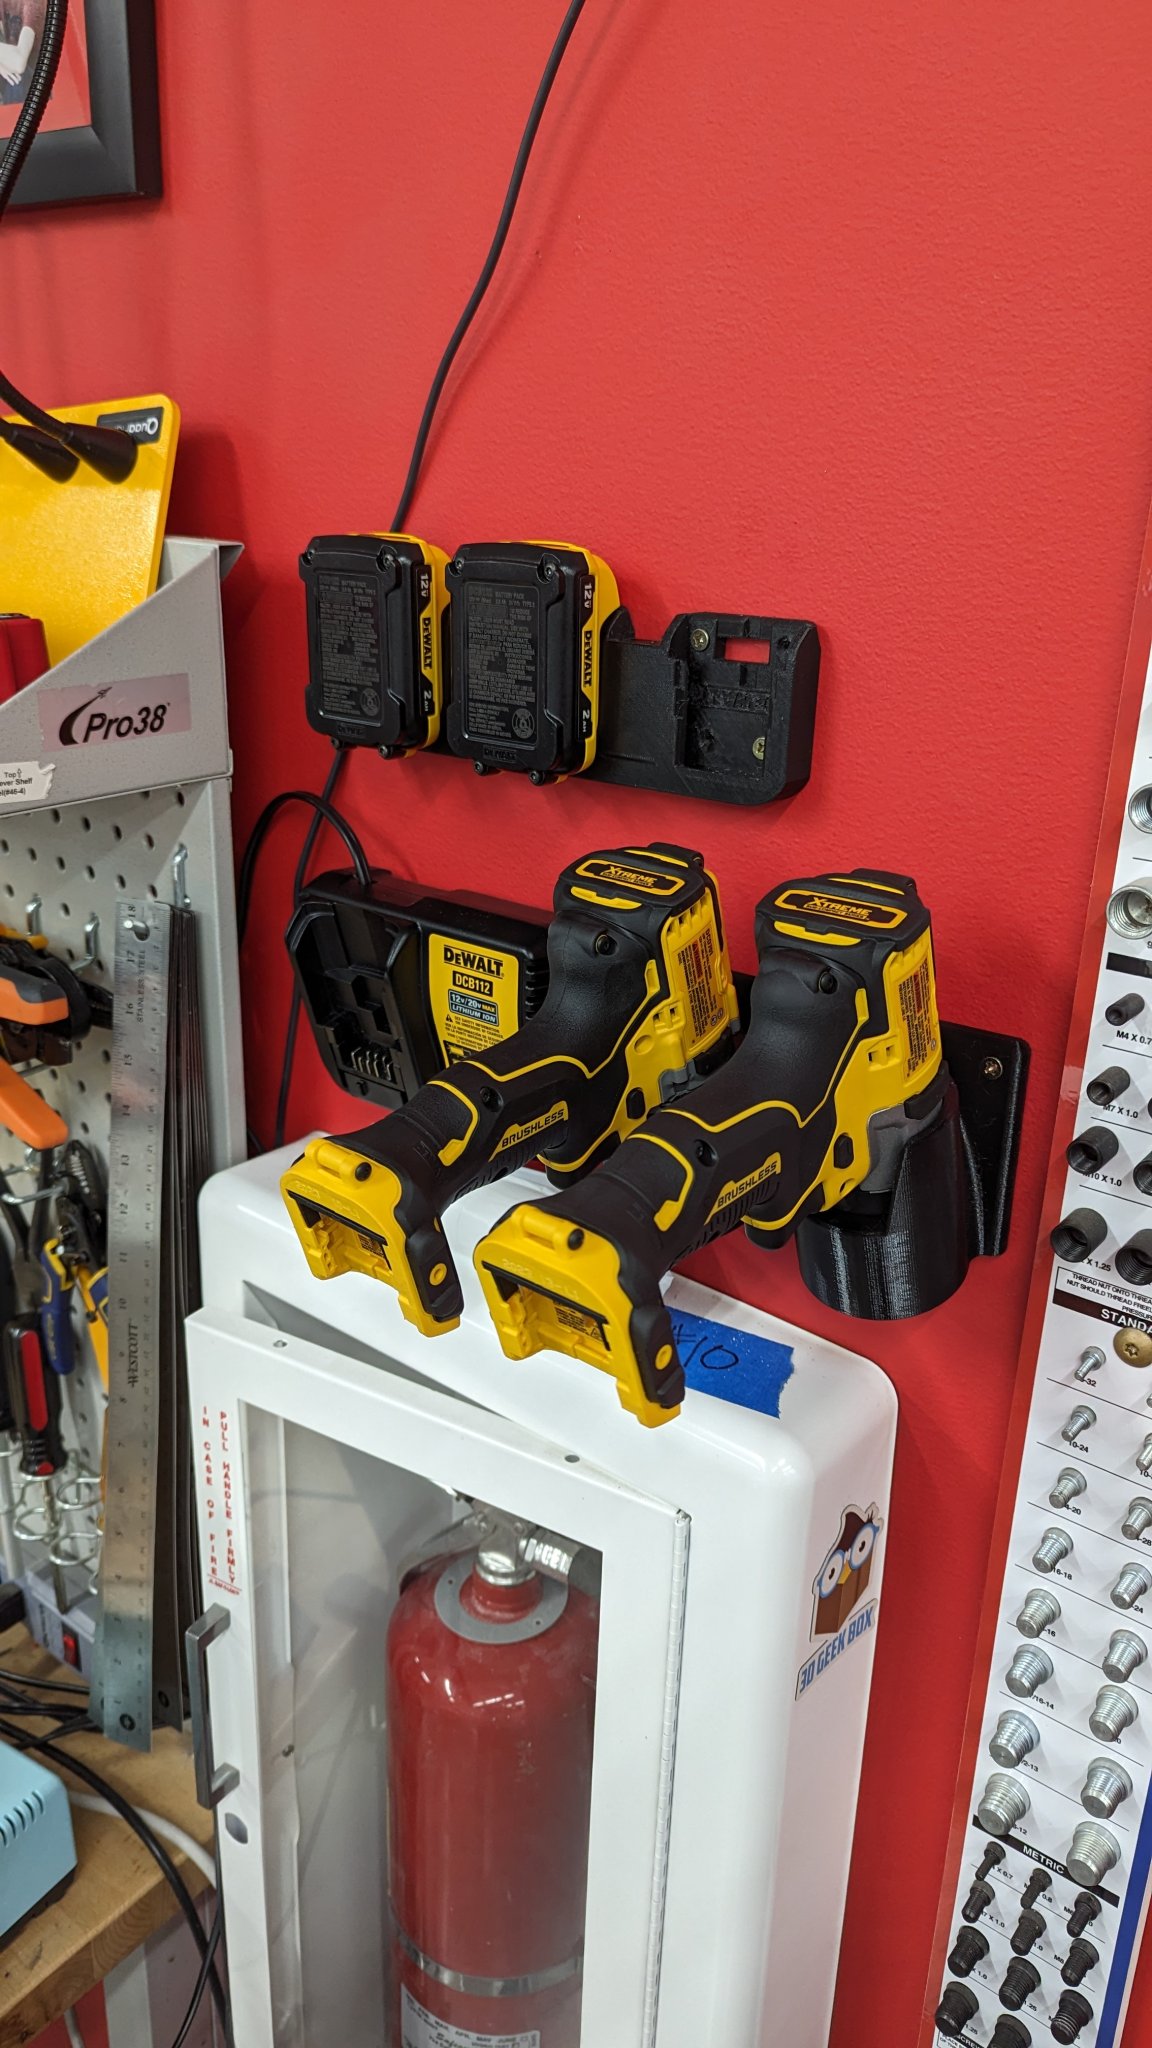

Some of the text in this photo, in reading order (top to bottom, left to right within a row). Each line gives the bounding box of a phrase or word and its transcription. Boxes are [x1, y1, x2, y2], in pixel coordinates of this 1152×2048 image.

[424, 690, 432, 699] 2
[583, 709, 590, 719] 2
[82, 703, 168, 743] Pro38
[4, 771, 17, 779] Top
[15, 777, 33, 785] Shelf
[605, 865, 658, 885] XTREME
[128, 905, 136, 919] 18
[806, 896, 873, 916] XTREME
[127, 950, 135, 963] 17
[443, 946, 503, 977] DEWALT
[136, 950, 146, 1024] STAINLESS STEEL
[455, 973, 491, 994] DCB112
[126, 1003, 134, 1015] 16
[452, 1005, 496, 1023] LITHIUM ION
[1116, 1030, 1129, 1040] M4
[1131, 1034, 1138, 1042] X
[124, 1054, 133, 1066] 15
[122, 1104, 130, 1116] 14
[1126, 1109, 1138, 1118] 1.0
[502, 1109, 564, 1148] BRUSHLESS
[121, 1154, 130, 1166] 13
[718, 1160, 778, 1208] BRUSHLESS
[1102, 1174, 1109, 1182] X
[1110, 1177, 1122, 1187] 1.0
[120, 1202, 128, 1215] 12
[1087, 1258, 1111, 1271] X 1.25
[1072, 1272, 1098, 1288] THREAD
[1098, 1281, 1112, 1291] NUT
[1111, 1286, 1130, 1297] ONTO
[1066, 1279, 1080, 1287] NUT
[1080, 1283, 1106, 1296] SHOULD
[1107, 1292, 1132, 1306] THREAD
[127, 1323, 138, 1389] WESTCOTT
[1068, 1441, 1089, 1453] 10-24
[203, 1406, 217, 1576] IN CASE OF FIRE
[220, 1411, 236, 1584] PULL HANDLE FIRMLY
[800, 1605, 873, 1694] 3D GEEK BOX
[1022, 1845, 1064, 1874] METRIC
[995, 1919, 1005, 1928] 1.0
